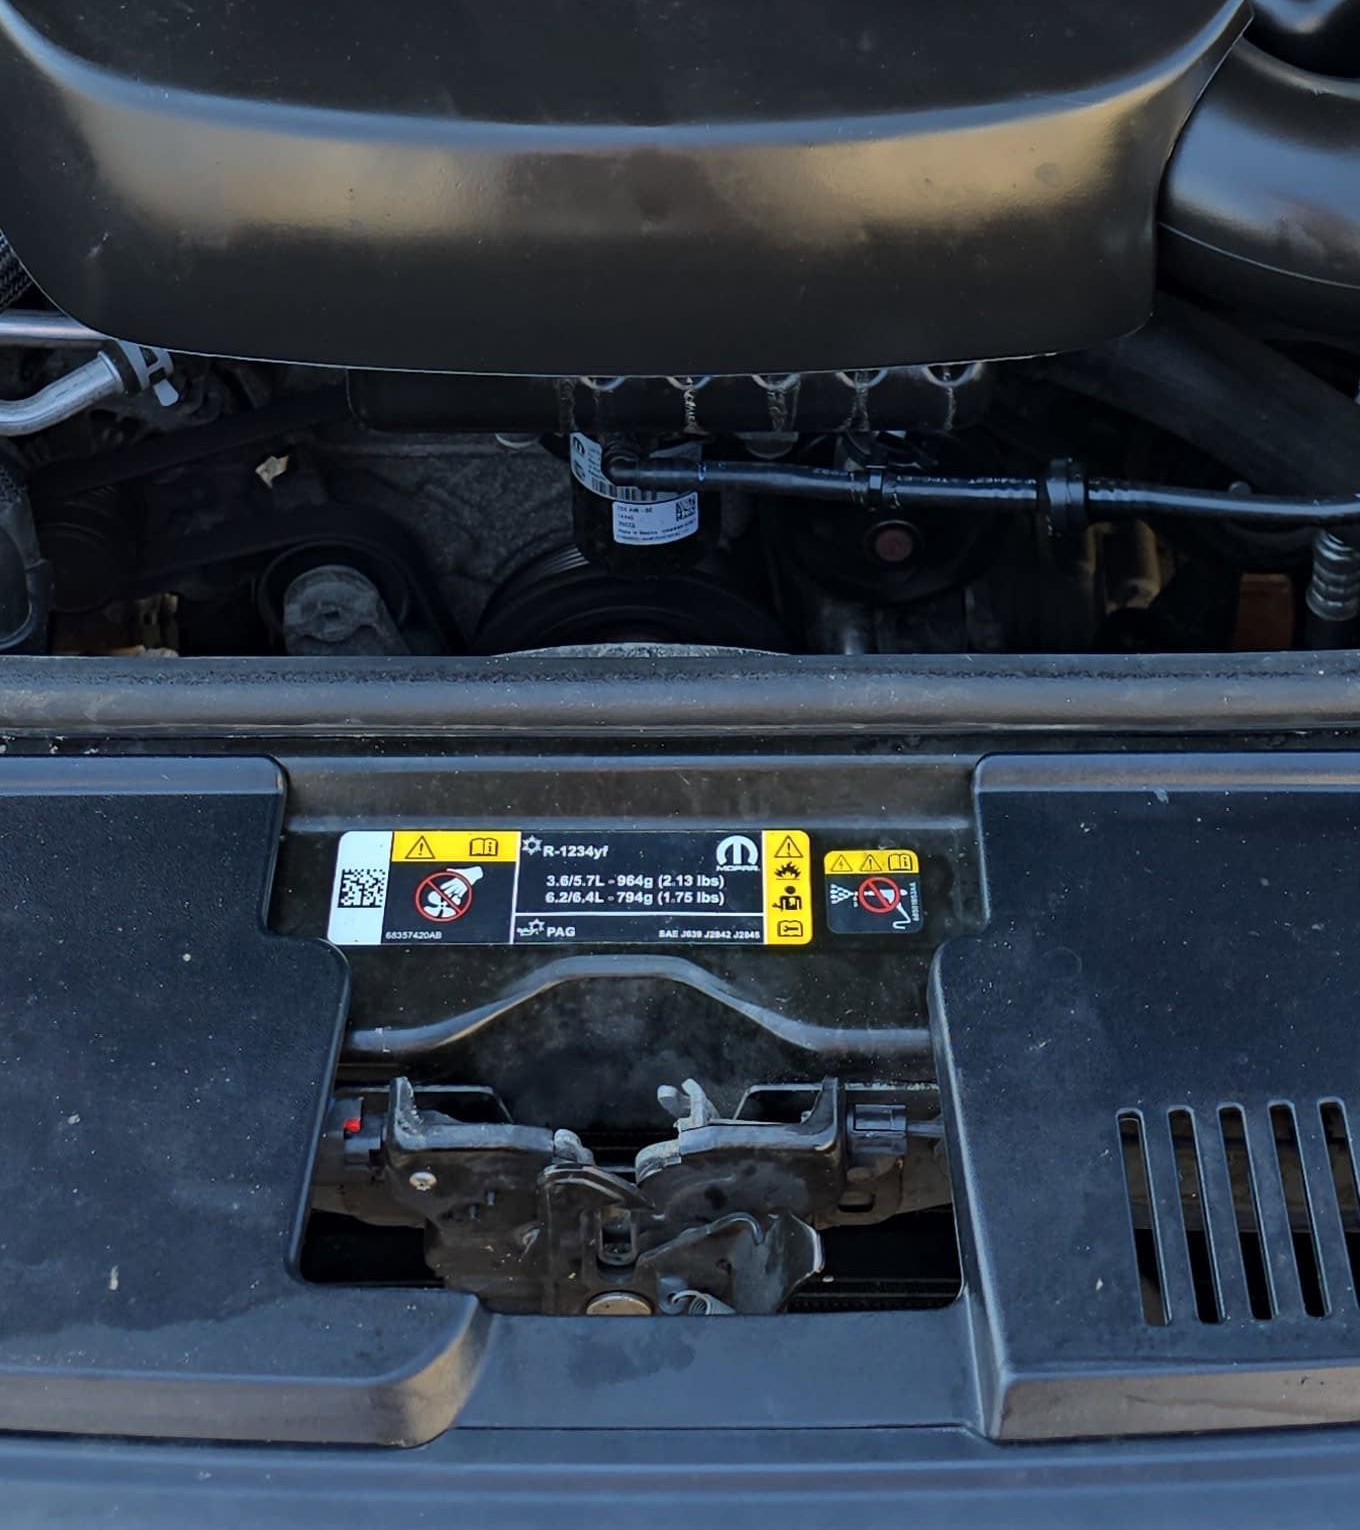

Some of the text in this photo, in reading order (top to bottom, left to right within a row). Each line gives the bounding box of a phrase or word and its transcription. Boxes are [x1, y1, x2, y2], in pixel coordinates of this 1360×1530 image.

[543, 845, 609, 860] R-1234yf
[546, 874, 606, 887] 3.6/5.7L
[617, 874, 654, 889] 964g
[658, 873, 694, 889] (2.13
[696, 873, 725, 890] lbs)
[545, 892, 605, 904] 6.2/6.4L
[616, 891, 654, 906] 794g
[657, 890, 694, 906] (1.75
[696, 890, 725, 906] lbs)
[546, 926, 576, 938] PAG
